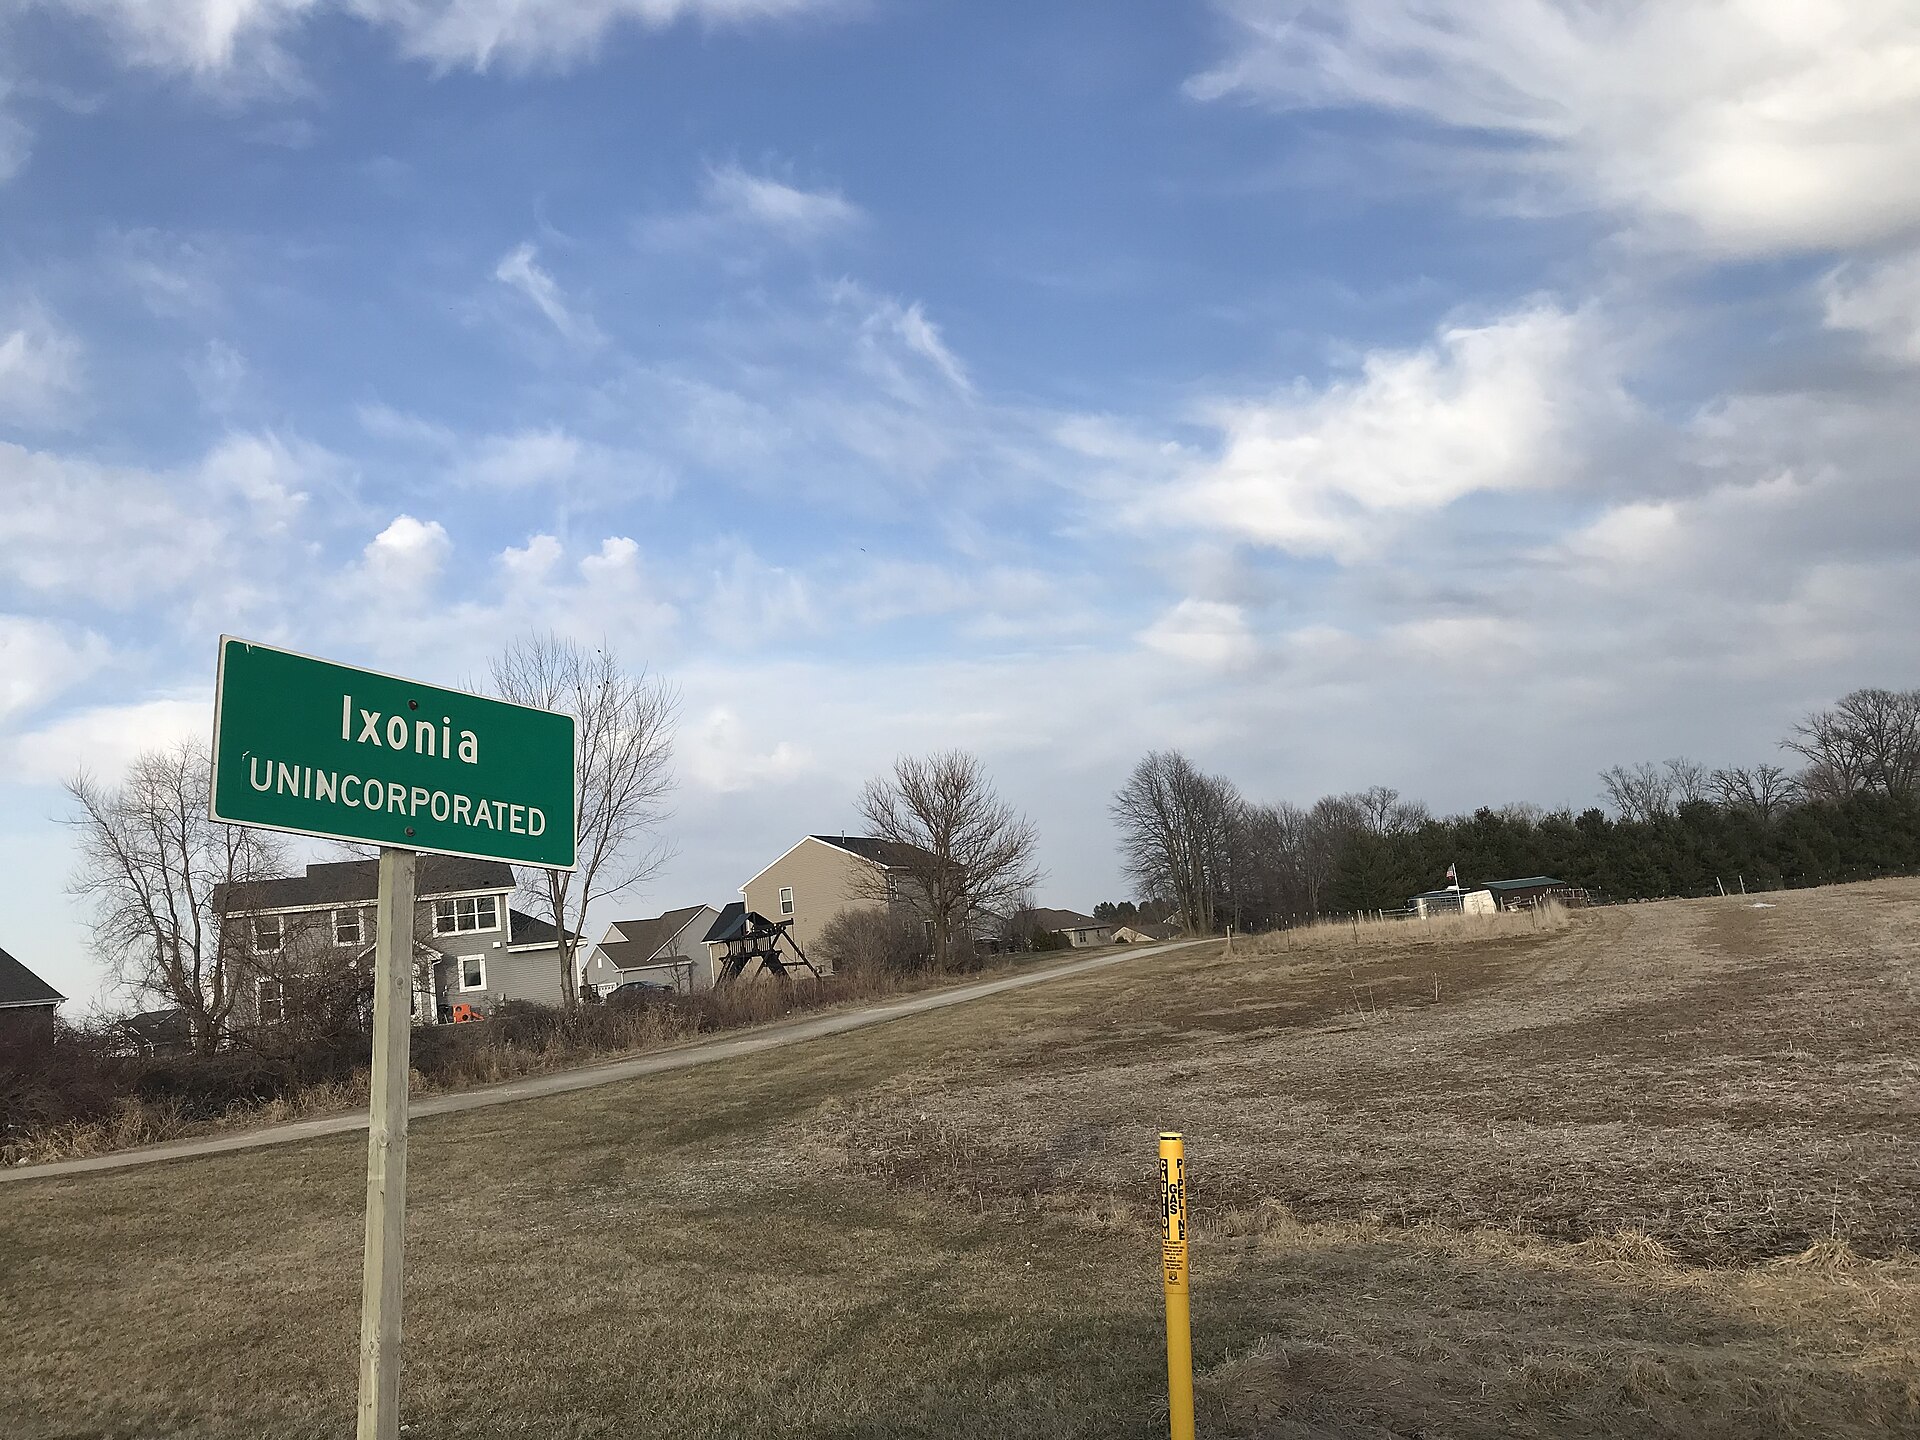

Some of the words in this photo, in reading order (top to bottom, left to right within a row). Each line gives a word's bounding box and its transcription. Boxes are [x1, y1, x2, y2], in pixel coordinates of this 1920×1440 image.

[342, 695, 478, 765] Ixonia
[249, 756, 546, 837] UNINCORPORATED
[1160, 1159, 1168, 1239] CAUTION
[1169, 1184, 1177, 1215] GAS
[1177, 1159, 1185, 1240] PIPELINE
